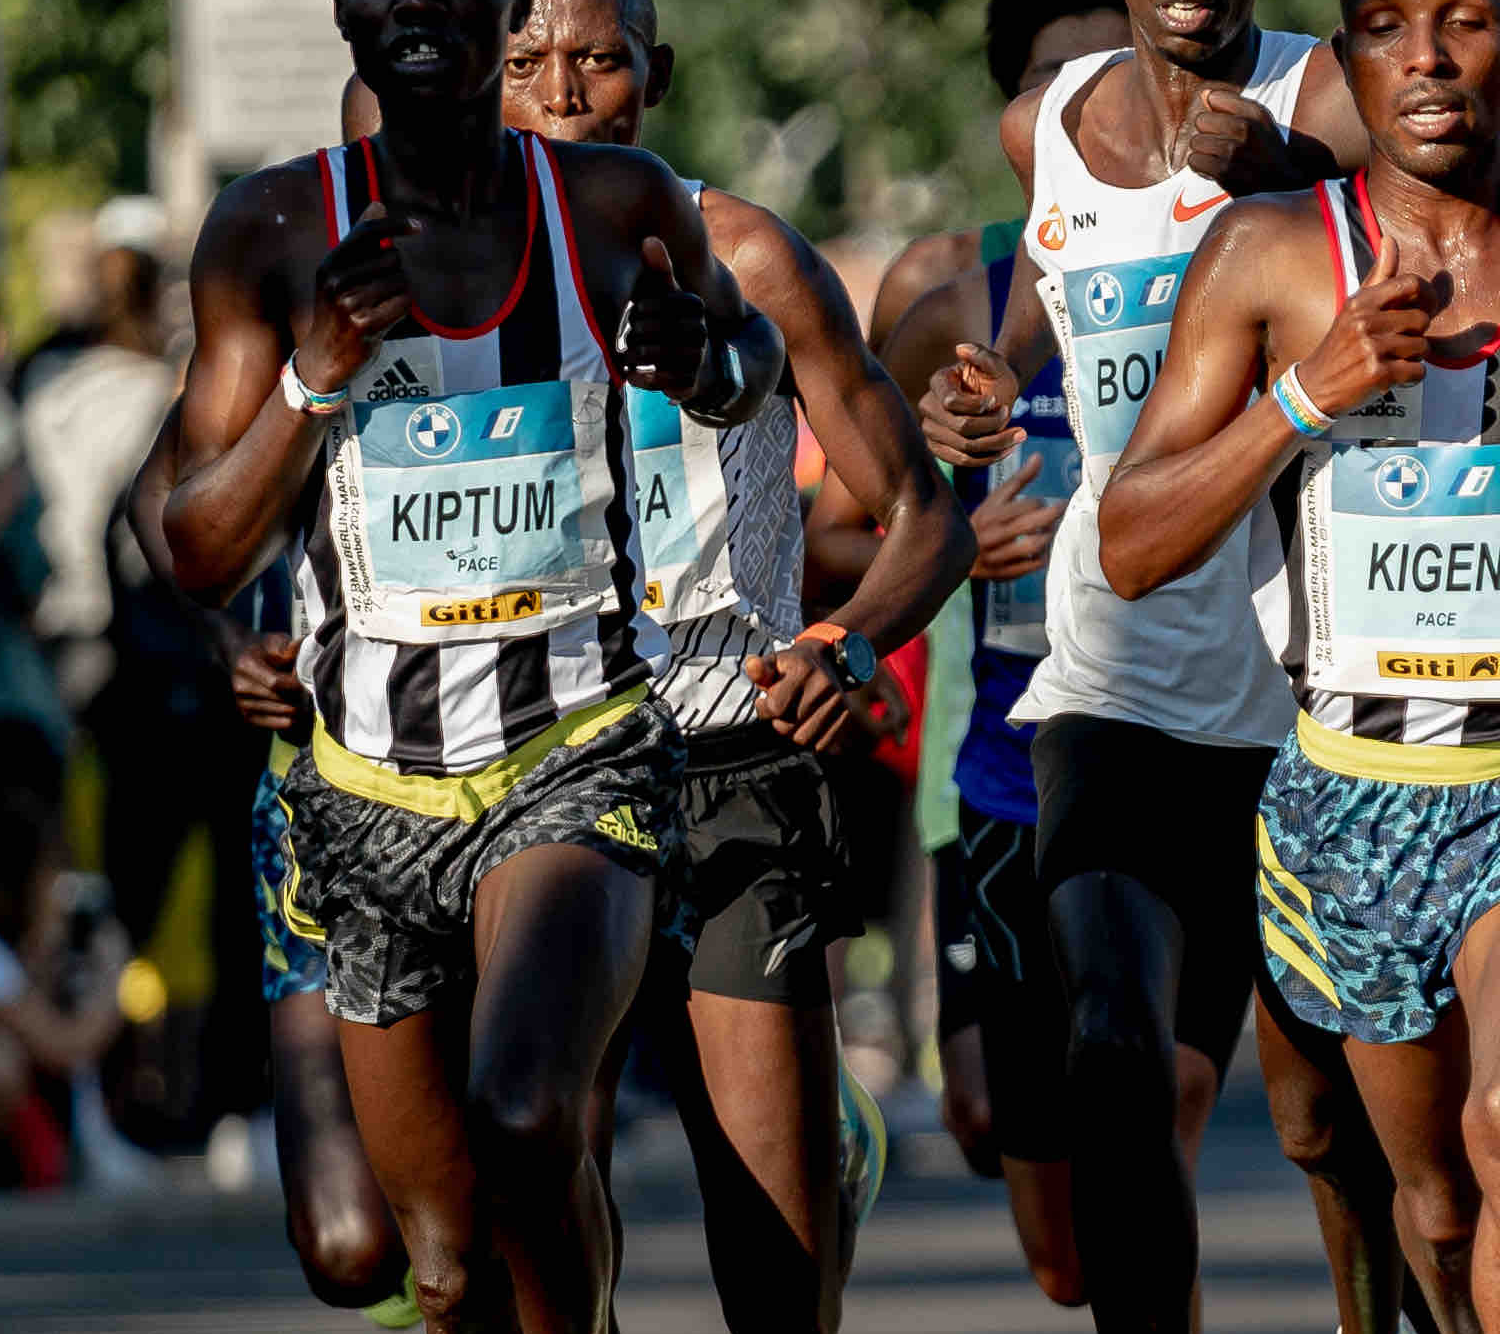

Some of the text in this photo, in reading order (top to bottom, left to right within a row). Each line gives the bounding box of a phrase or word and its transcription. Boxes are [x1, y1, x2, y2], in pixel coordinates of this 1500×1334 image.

[1072, 213, 1097, 230] NN
[367, 384, 430, 402] adidas
[392, 479, 556, 542] KIPTUM
[457, 556, 499, 573] PACE
[429, 597, 501, 623] Giti
[1415, 612, 1458, 627] PACE
[1386, 657, 1455, 678] Giti
[595, 819, 659, 851] adidas
